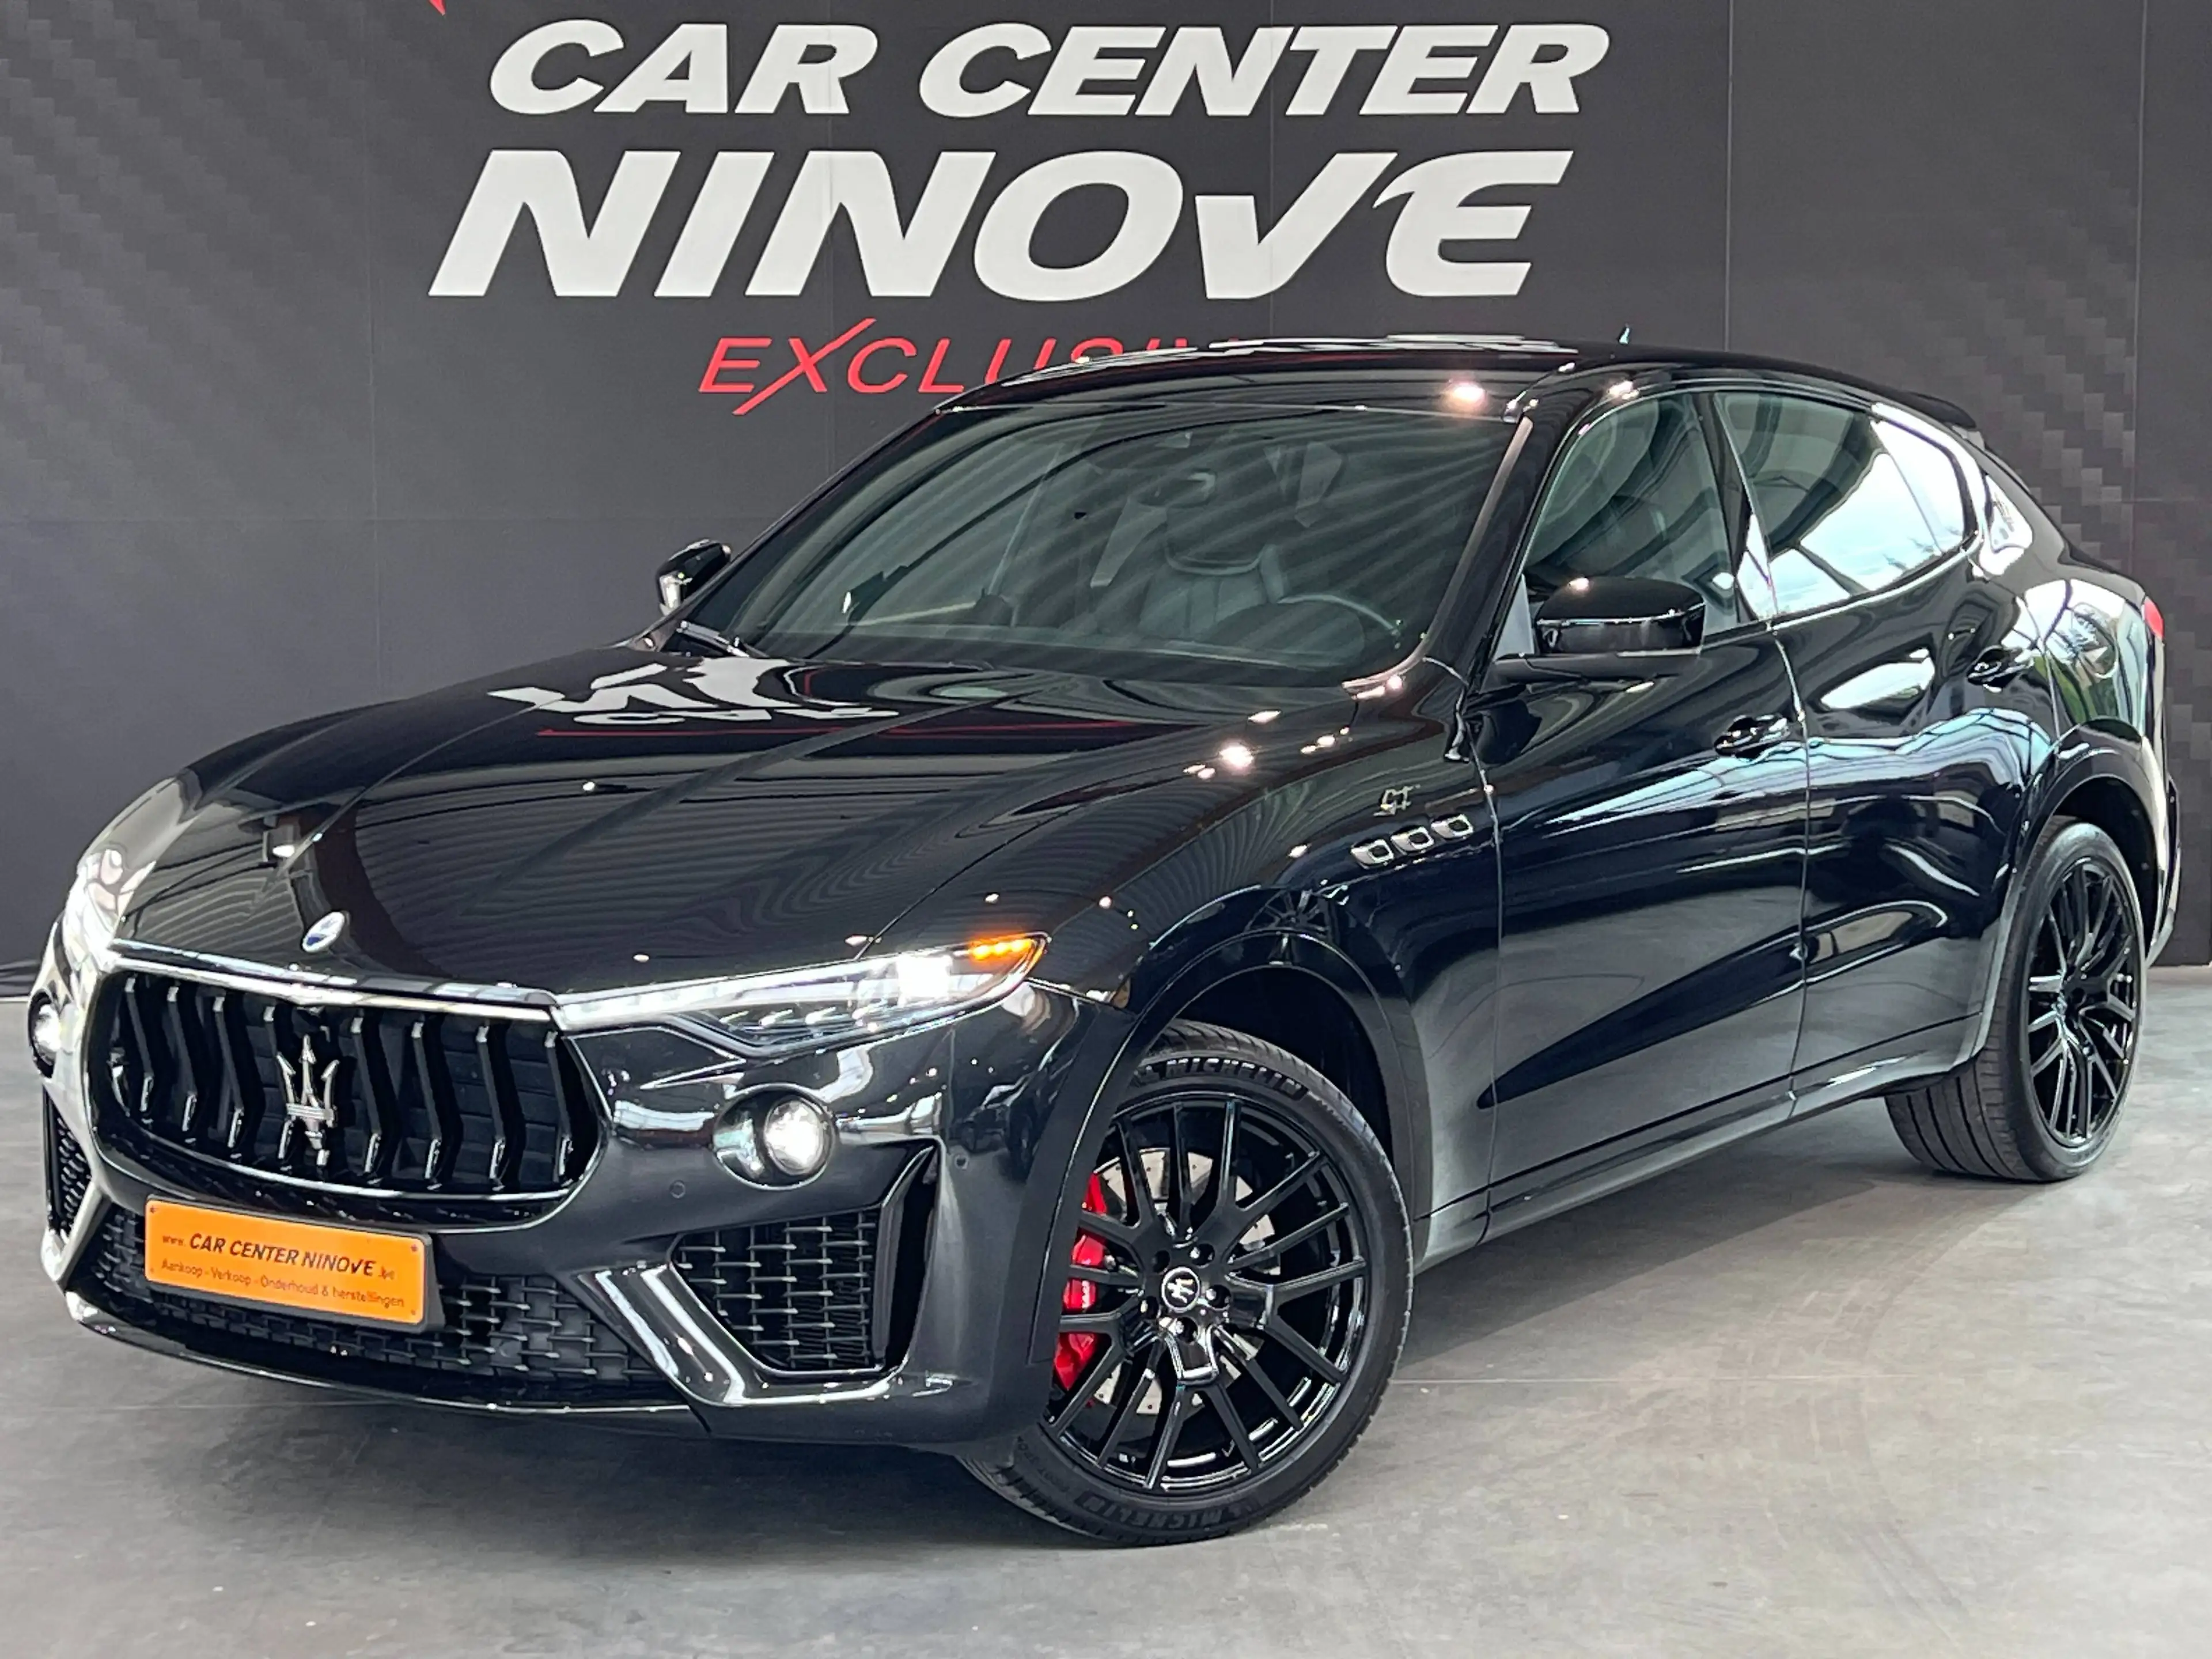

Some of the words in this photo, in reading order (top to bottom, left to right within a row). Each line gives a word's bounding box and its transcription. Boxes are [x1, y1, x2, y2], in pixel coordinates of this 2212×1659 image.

[490, 20, 878, 114] CAR
[919, 23, 1609, 118] CENTER
[428, 150, 1574, 301] NINOVE
[1166, 1057, 1302, 1096] MICHELIN
[190, 1232, 226, 1254] CAR
[230, 1240, 300, 1266] CENTER
[301, 1250, 377, 1277] NINOVE
[161, 1257, 203, 1279] Aankoop
[210, 1267, 251, 1287] Verkoop
[260, 1274, 319, 1295] Onderhoud
[332, 1286, 404, 1309] herstellingen
